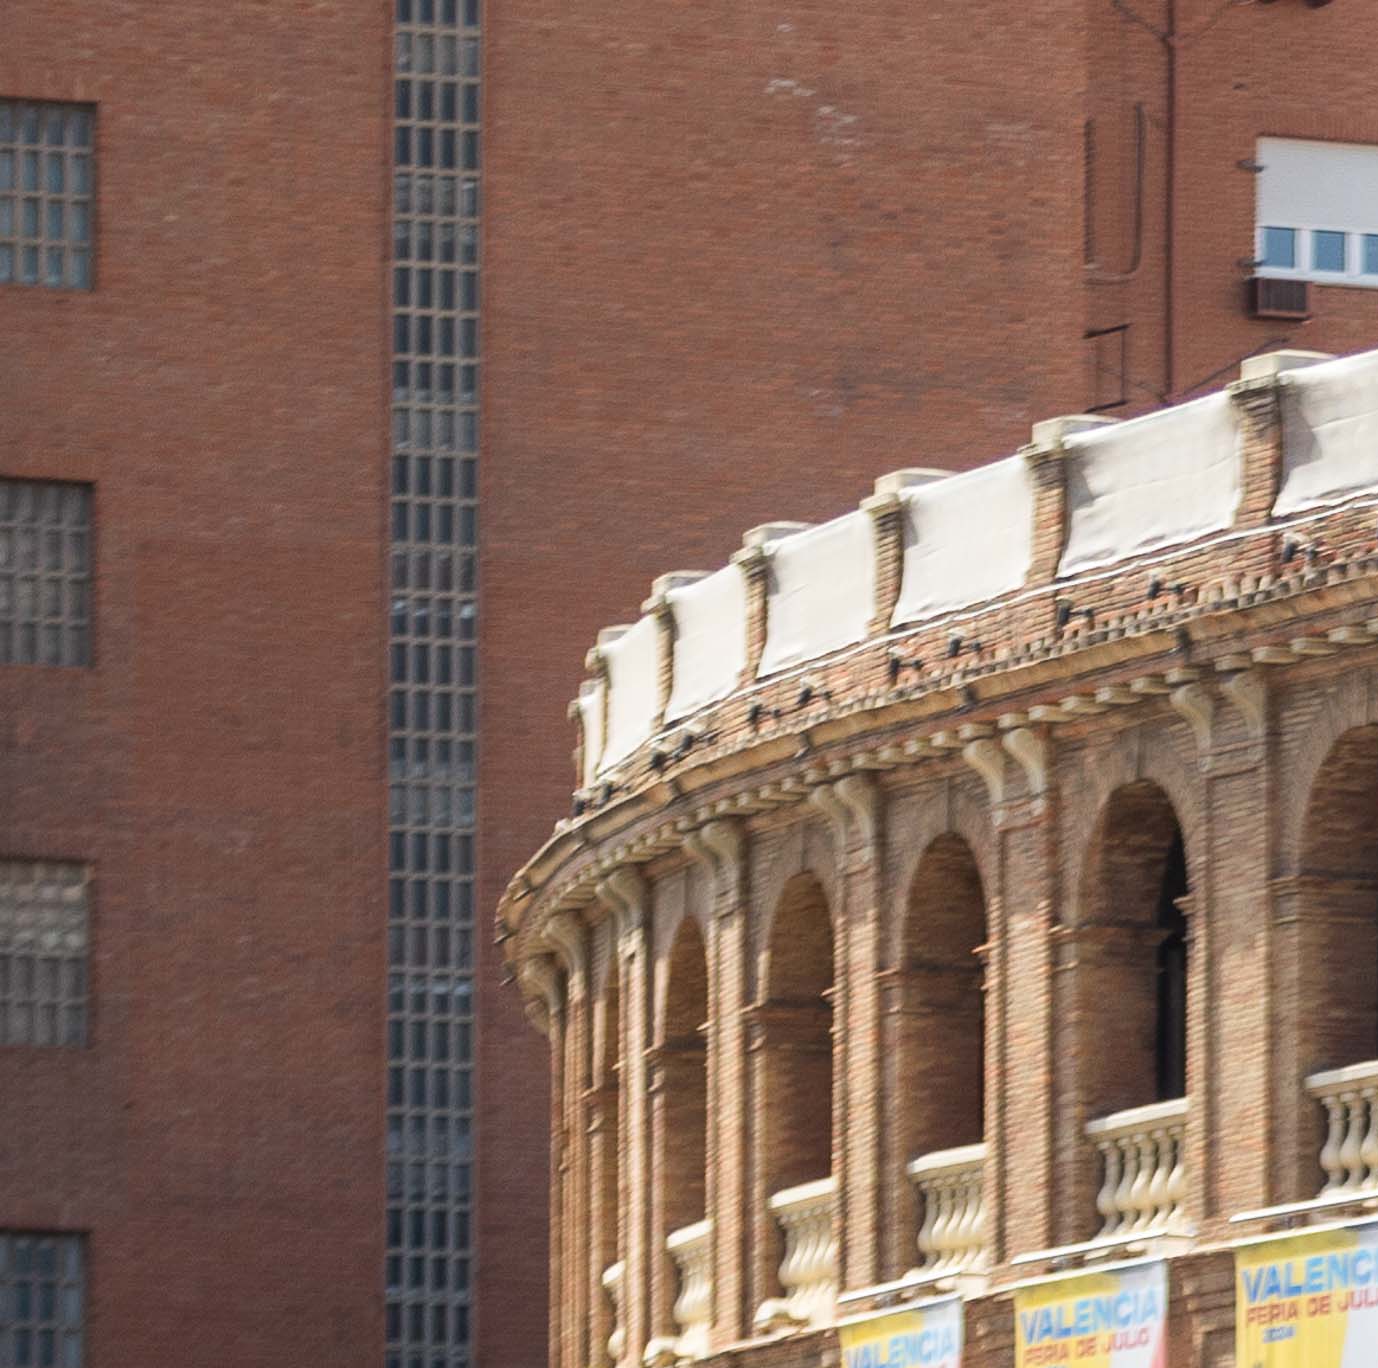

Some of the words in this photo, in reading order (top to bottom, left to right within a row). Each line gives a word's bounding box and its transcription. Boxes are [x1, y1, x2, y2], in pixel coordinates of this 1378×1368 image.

[1021, 1289, 1159, 1346] VALENCIA
[1247, 1299, 1298, 1327] FERIA
[1308, 1295, 1331, 1317] DE
[1024, 1342, 1069, 1367] FERIA
[1076, 1336, 1097, 1358] DE
[1104, 1326, 1150, 1354] JULIO
